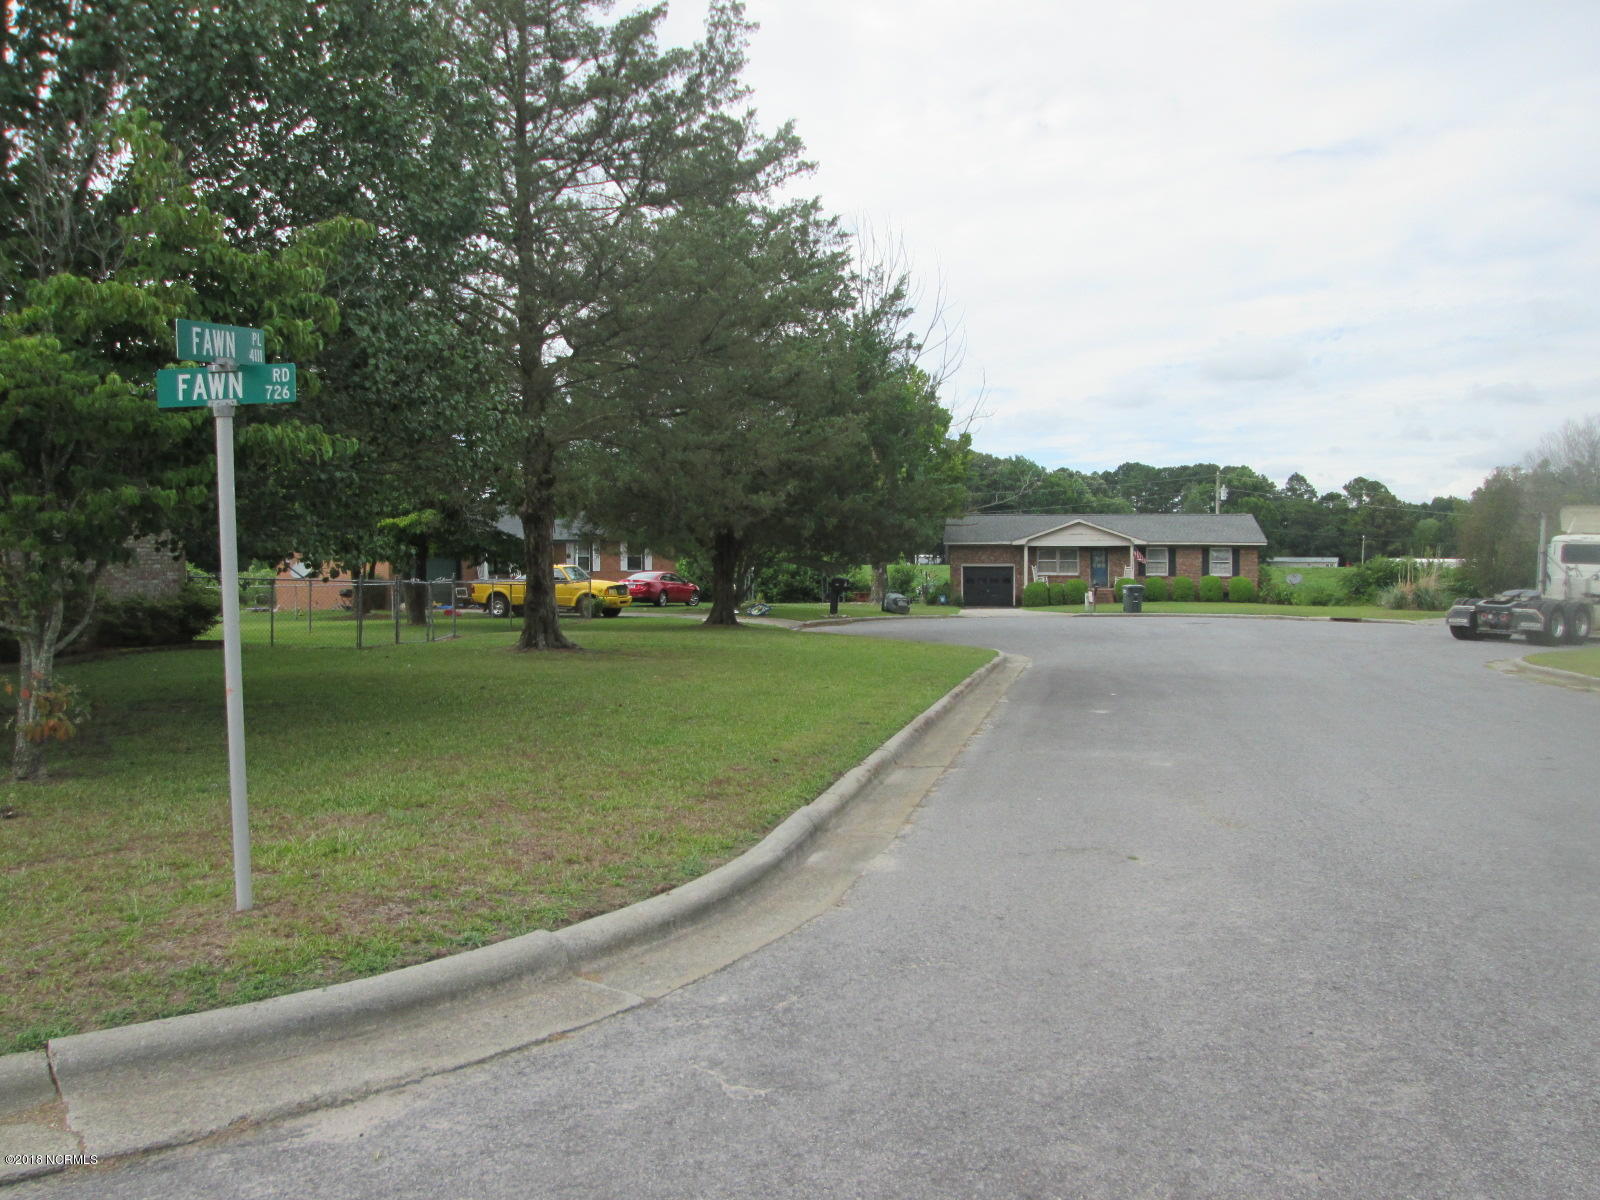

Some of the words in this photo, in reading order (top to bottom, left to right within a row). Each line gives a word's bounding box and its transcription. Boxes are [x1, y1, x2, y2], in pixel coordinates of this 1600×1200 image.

[191, 326, 236, 358] FAWN
[251, 332, 262, 347] PL
[177, 372, 244, 401] FAWN
[272, 368, 290, 382] RD
[265, 386, 290, 400] 726
